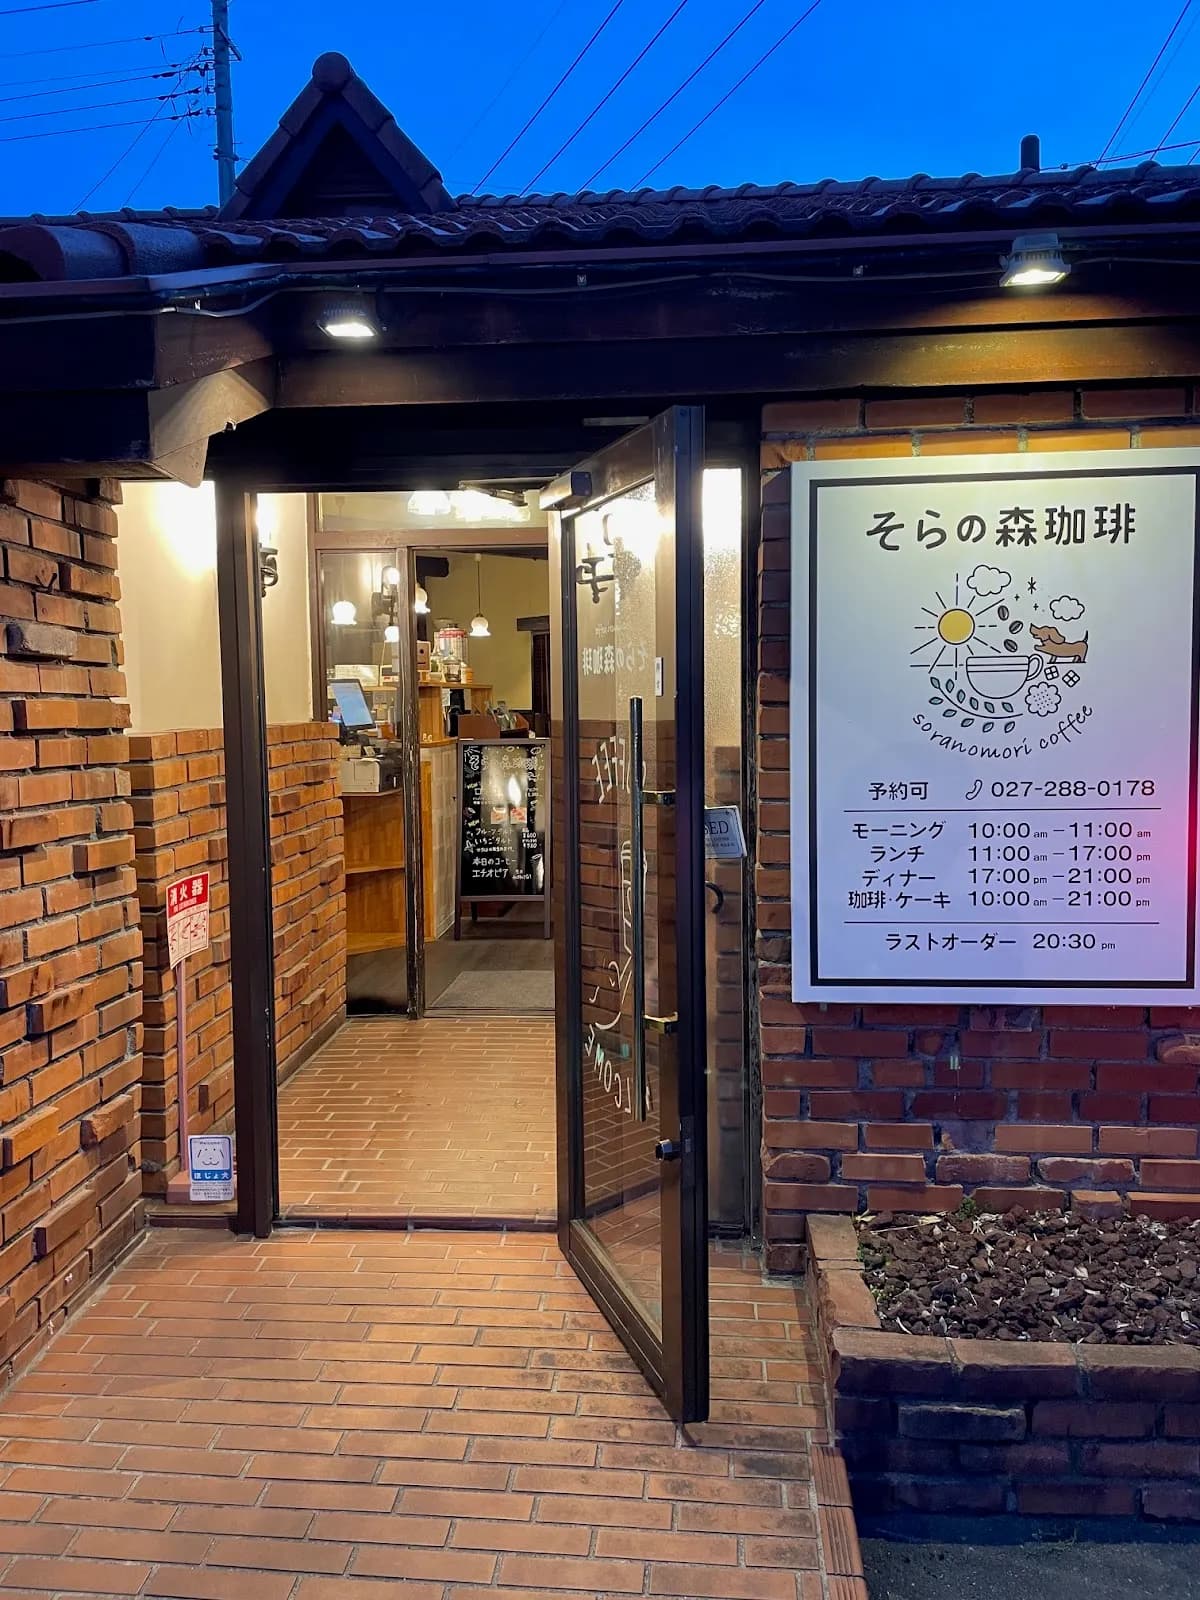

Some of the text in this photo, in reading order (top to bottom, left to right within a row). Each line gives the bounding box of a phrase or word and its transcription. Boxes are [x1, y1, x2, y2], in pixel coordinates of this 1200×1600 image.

[866, 502, 1136, 551] そらの森珈琲
[912, 704, 1093, 759] soranomori coffee
[868, 779, 1156, 800] 予約可 027-288-0178
[852, 819, 947, 839] モーニング
[870, 845, 925, 863] ランチ
[472, 868, 509, 879] エチオピア
[861, 868, 936, 887] ディナー
[169, 878, 204, 907] 消火器
[885, 932, 1016, 951] ラストオーダー
[1032, 933, 1097, 949] 20:30
